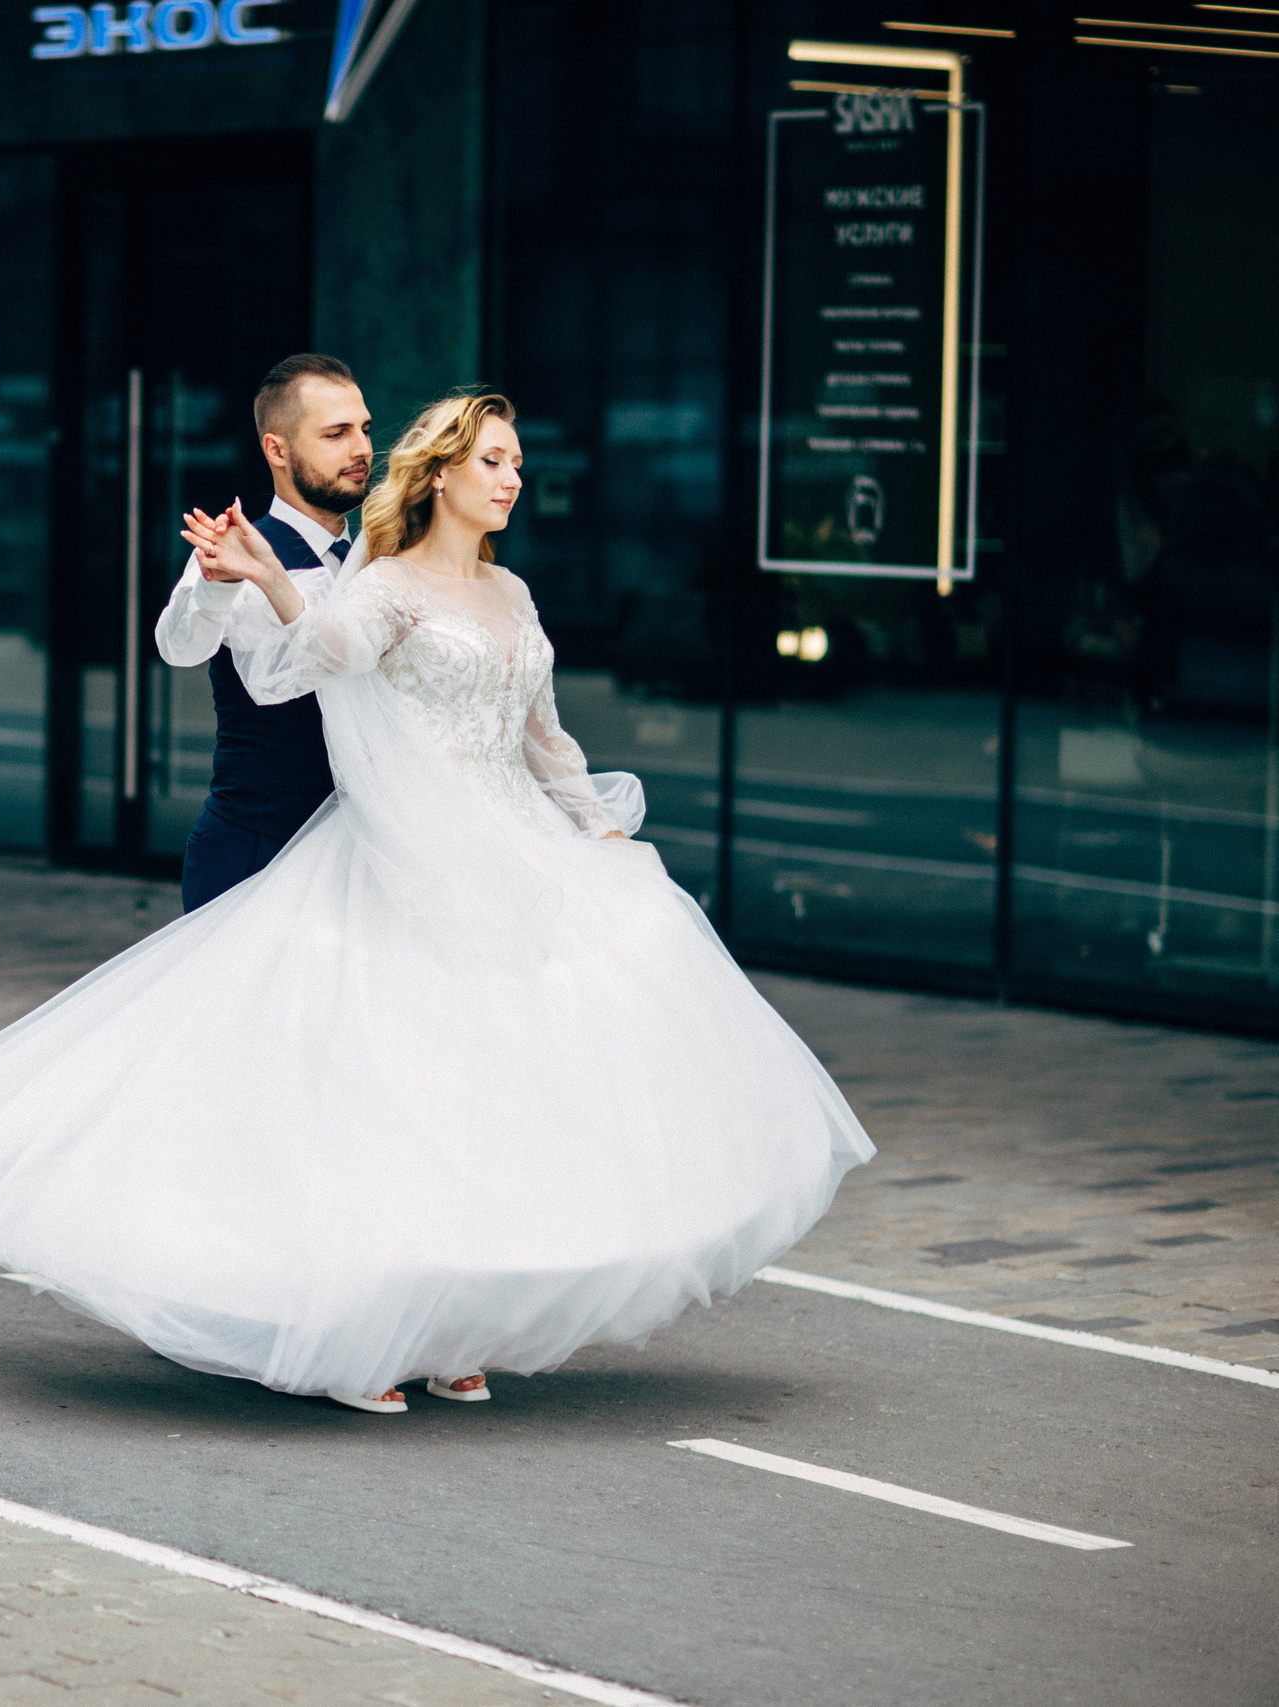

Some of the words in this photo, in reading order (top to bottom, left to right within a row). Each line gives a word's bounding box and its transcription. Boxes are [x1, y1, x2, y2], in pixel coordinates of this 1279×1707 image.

[31, 0, 283, 59] ЭКОС
[825, 186, 923, 207] МУЖСКИЕ
[836, 223, 913, 245] УСЛУГИ
